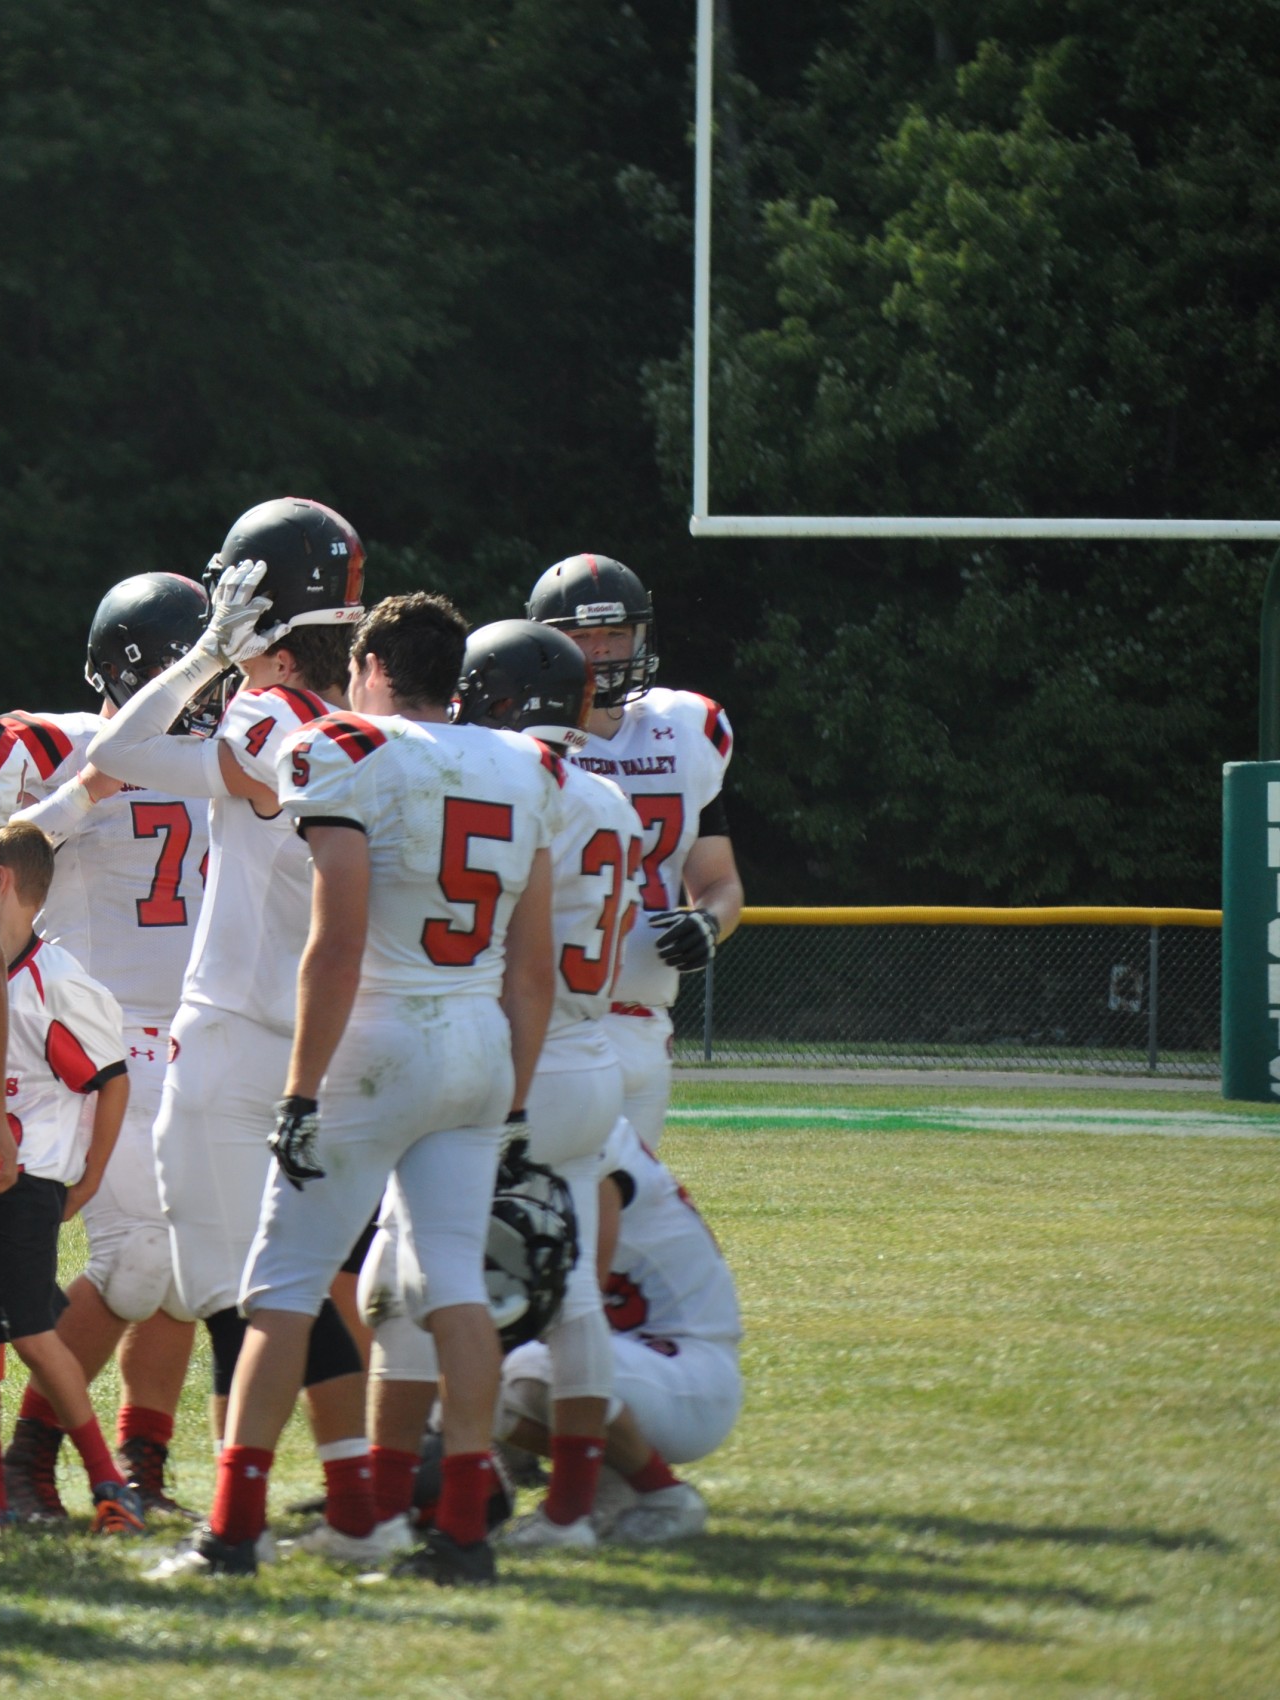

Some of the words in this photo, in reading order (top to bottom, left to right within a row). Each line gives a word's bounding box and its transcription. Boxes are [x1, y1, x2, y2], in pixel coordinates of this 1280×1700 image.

[245, 715, 277, 757] 4
[291, 742, 311, 787] 5
[570, 757, 619, 776] AUCON
[619, 755, 677, 776] VALLEY
[130, 801, 210, 927] 7
[421, 796, 514, 966] 5
[625, 792, 685, 912] 7
